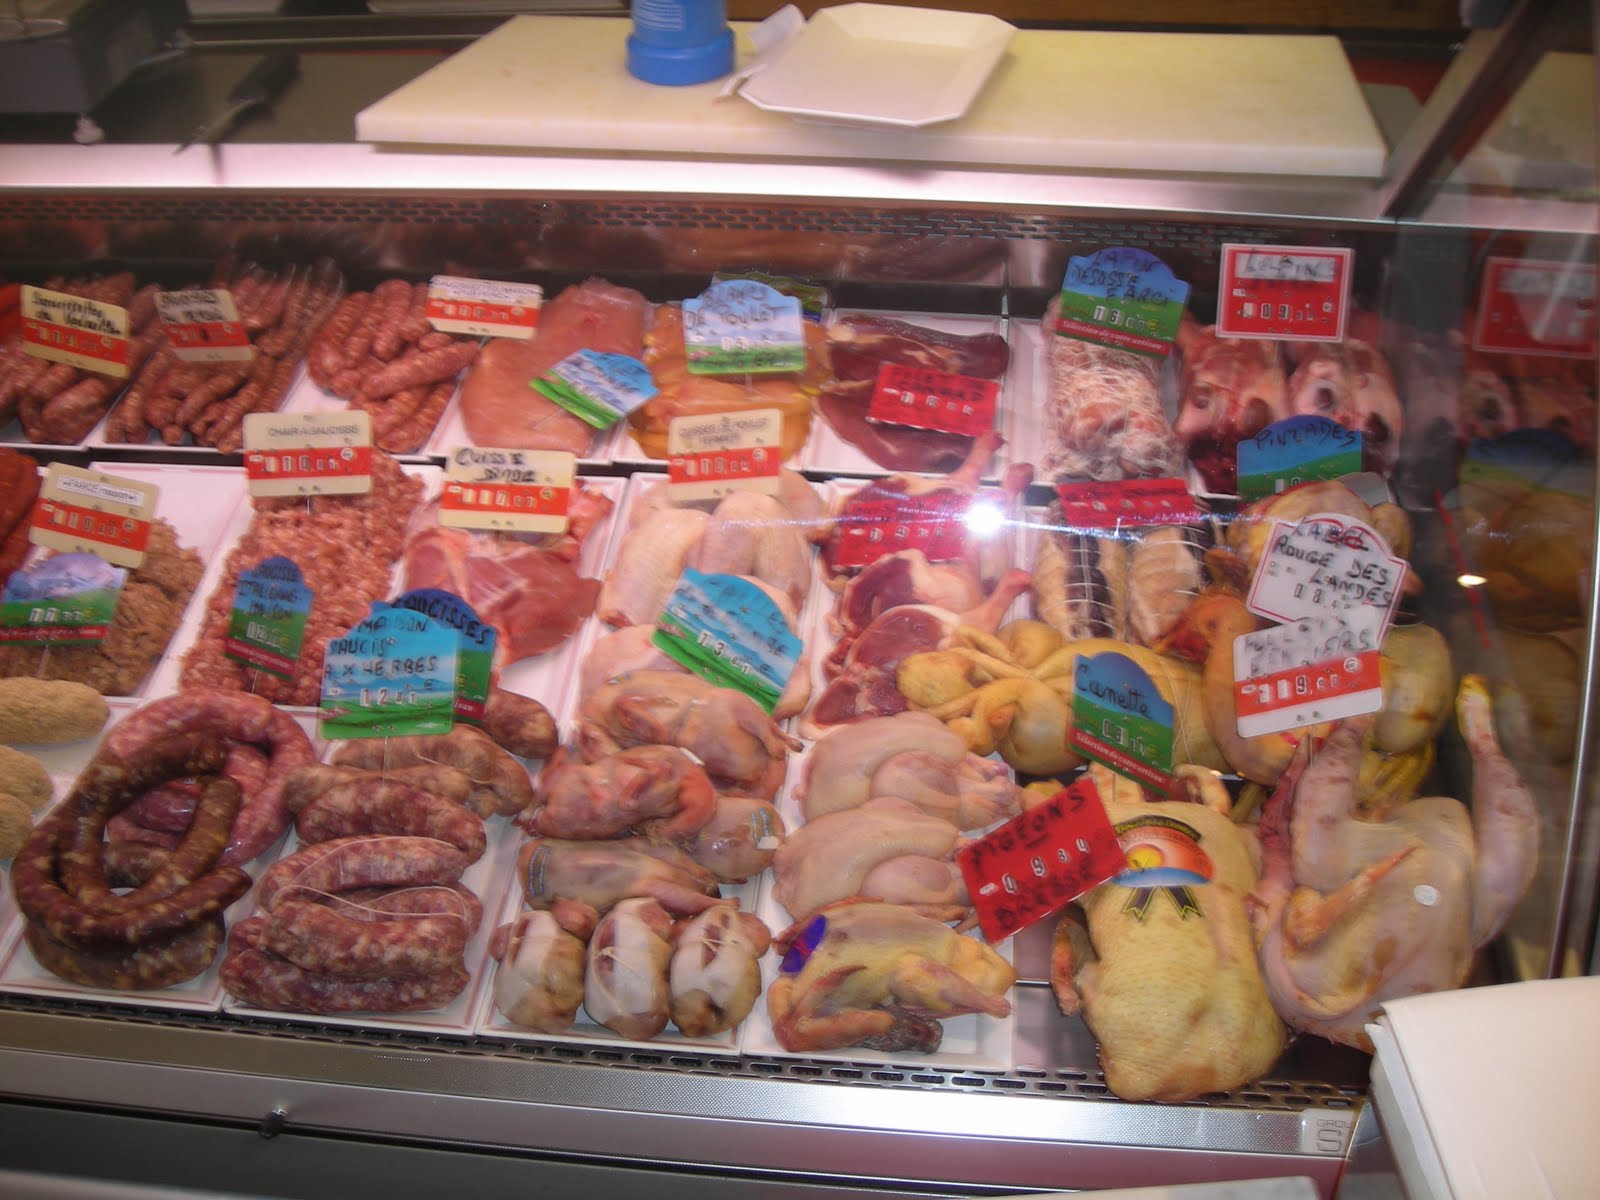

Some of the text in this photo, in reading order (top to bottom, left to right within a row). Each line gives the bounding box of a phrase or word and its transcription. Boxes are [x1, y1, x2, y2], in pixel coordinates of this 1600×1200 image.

[1274, 536, 1388, 585] ROUGE DES
[1310, 568, 1393, 608] LANDES
[1076, 732, 1109, 756] Sélection
